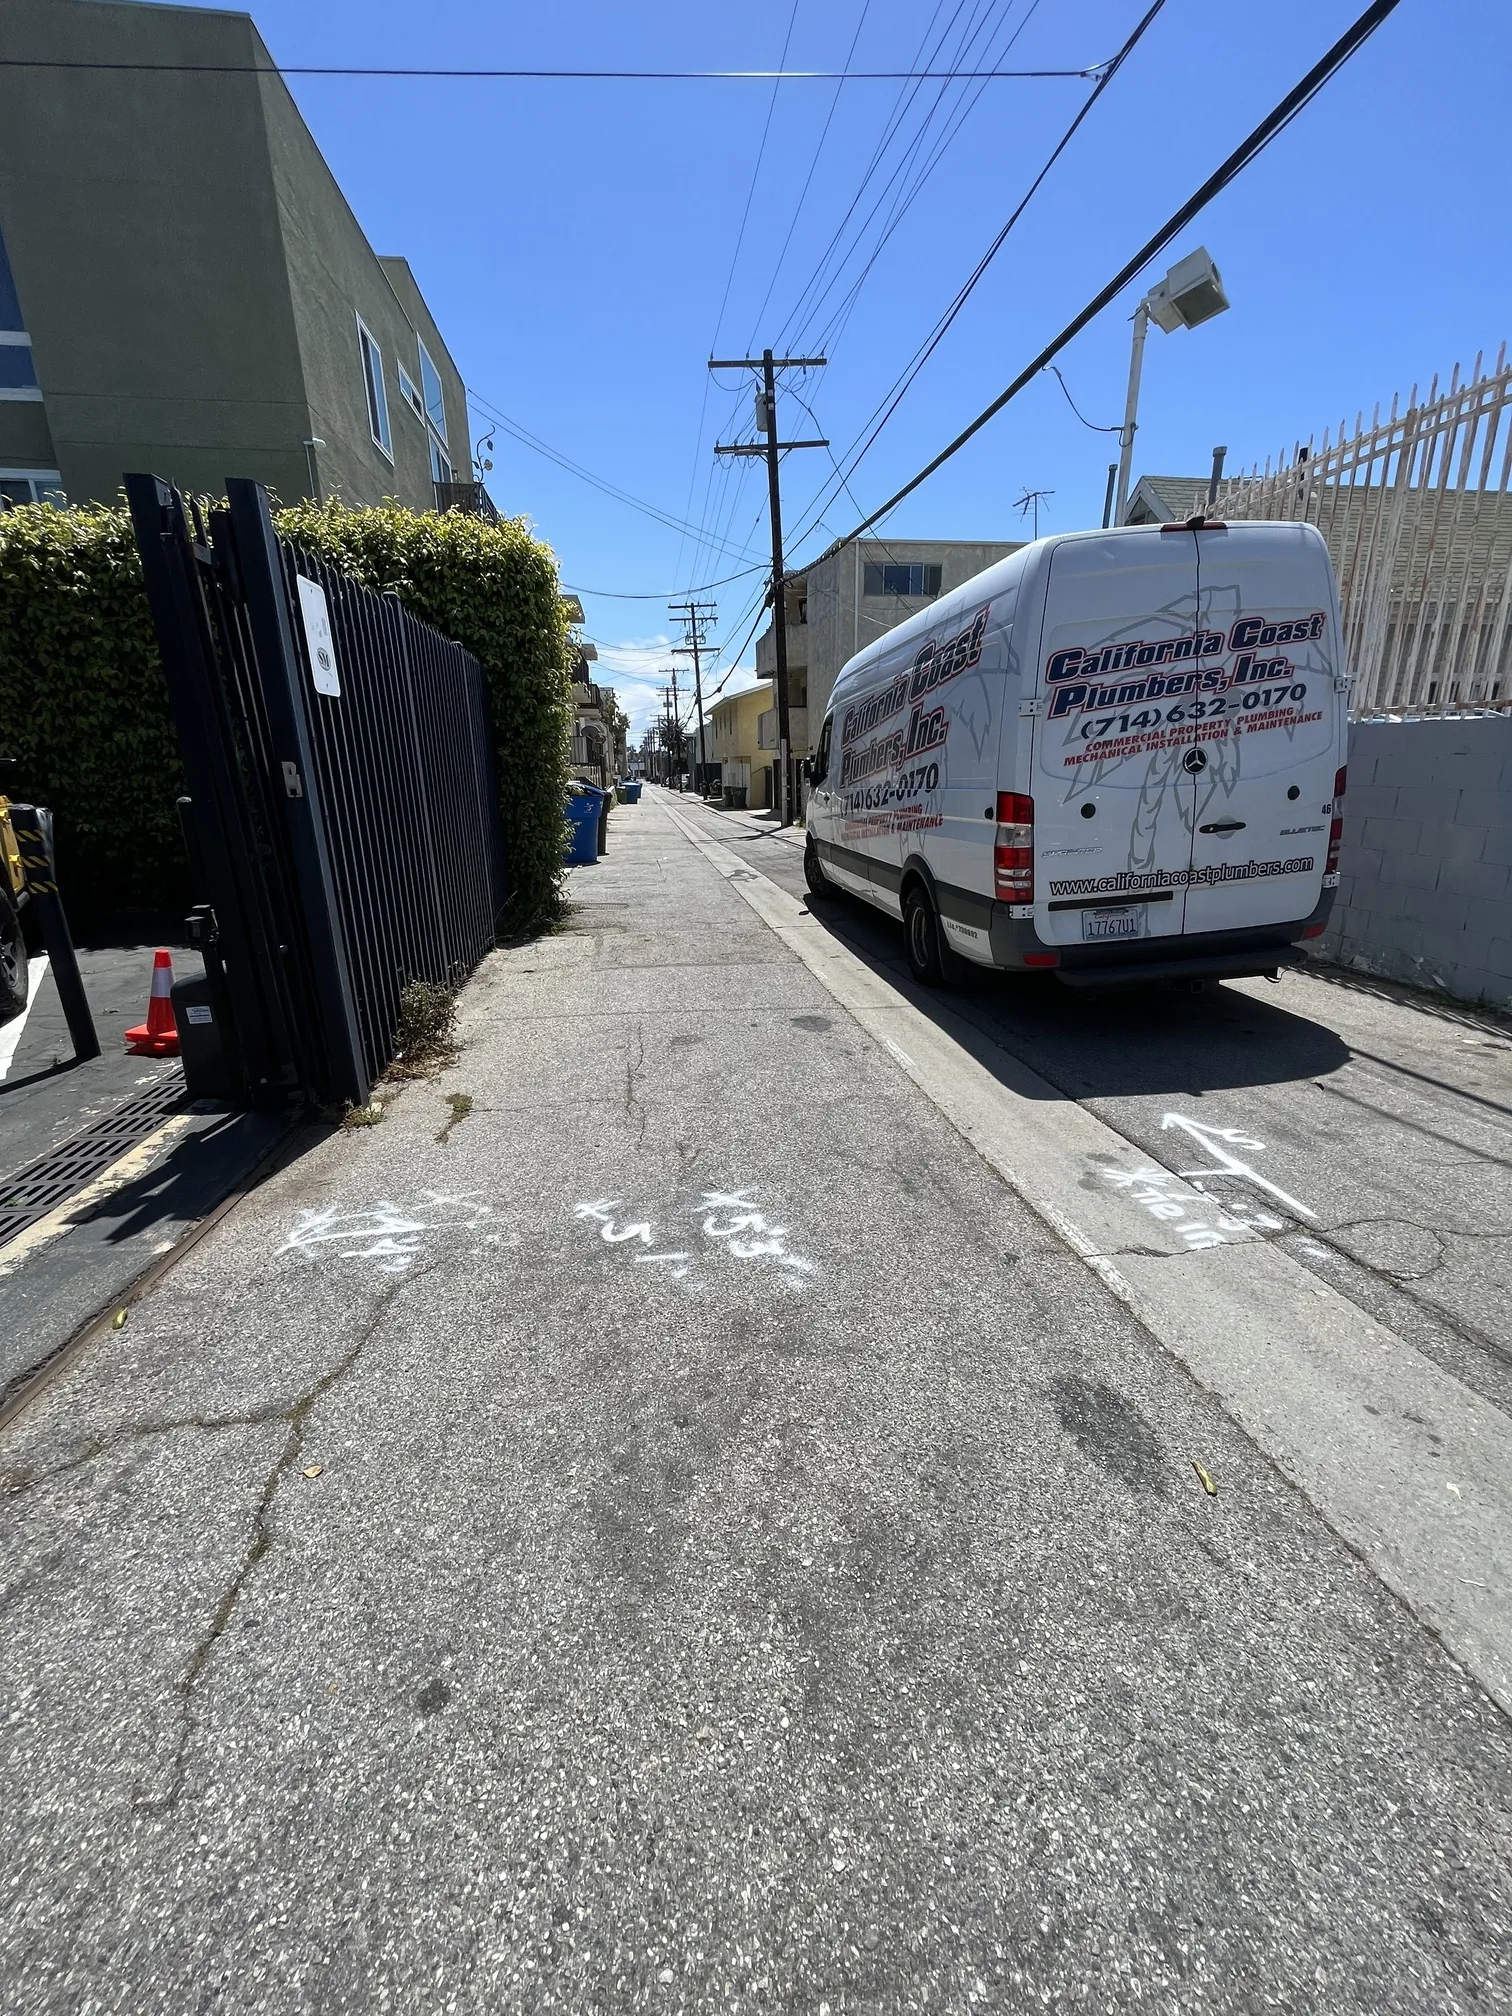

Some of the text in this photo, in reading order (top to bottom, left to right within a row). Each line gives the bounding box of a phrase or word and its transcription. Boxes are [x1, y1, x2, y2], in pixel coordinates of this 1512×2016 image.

[842, 603, 990, 749] California Coast
[1045, 612, 1326, 684] California Coast
[1047, 652, 1294, 720] Plumbers, Inc.
[1081, 683, 1307, 740] (714)632-0170
[840, 700, 949, 789] Plumbers, Inc.
[1064, 711, 1323, 767] MECHANICAL INSTALLATION & MAINTENANCE
[1086, 707, 1294, 753] COMMERCIAL PROPERTY PLUMBING
[897, 813, 944, 832] MAINTENANCE
[1321, 803, 1332, 815] 46
[1049, 857, 1314, 896] www.californiacoastplumbers.com
[1088, 918, 1137, 936] 17767U1
